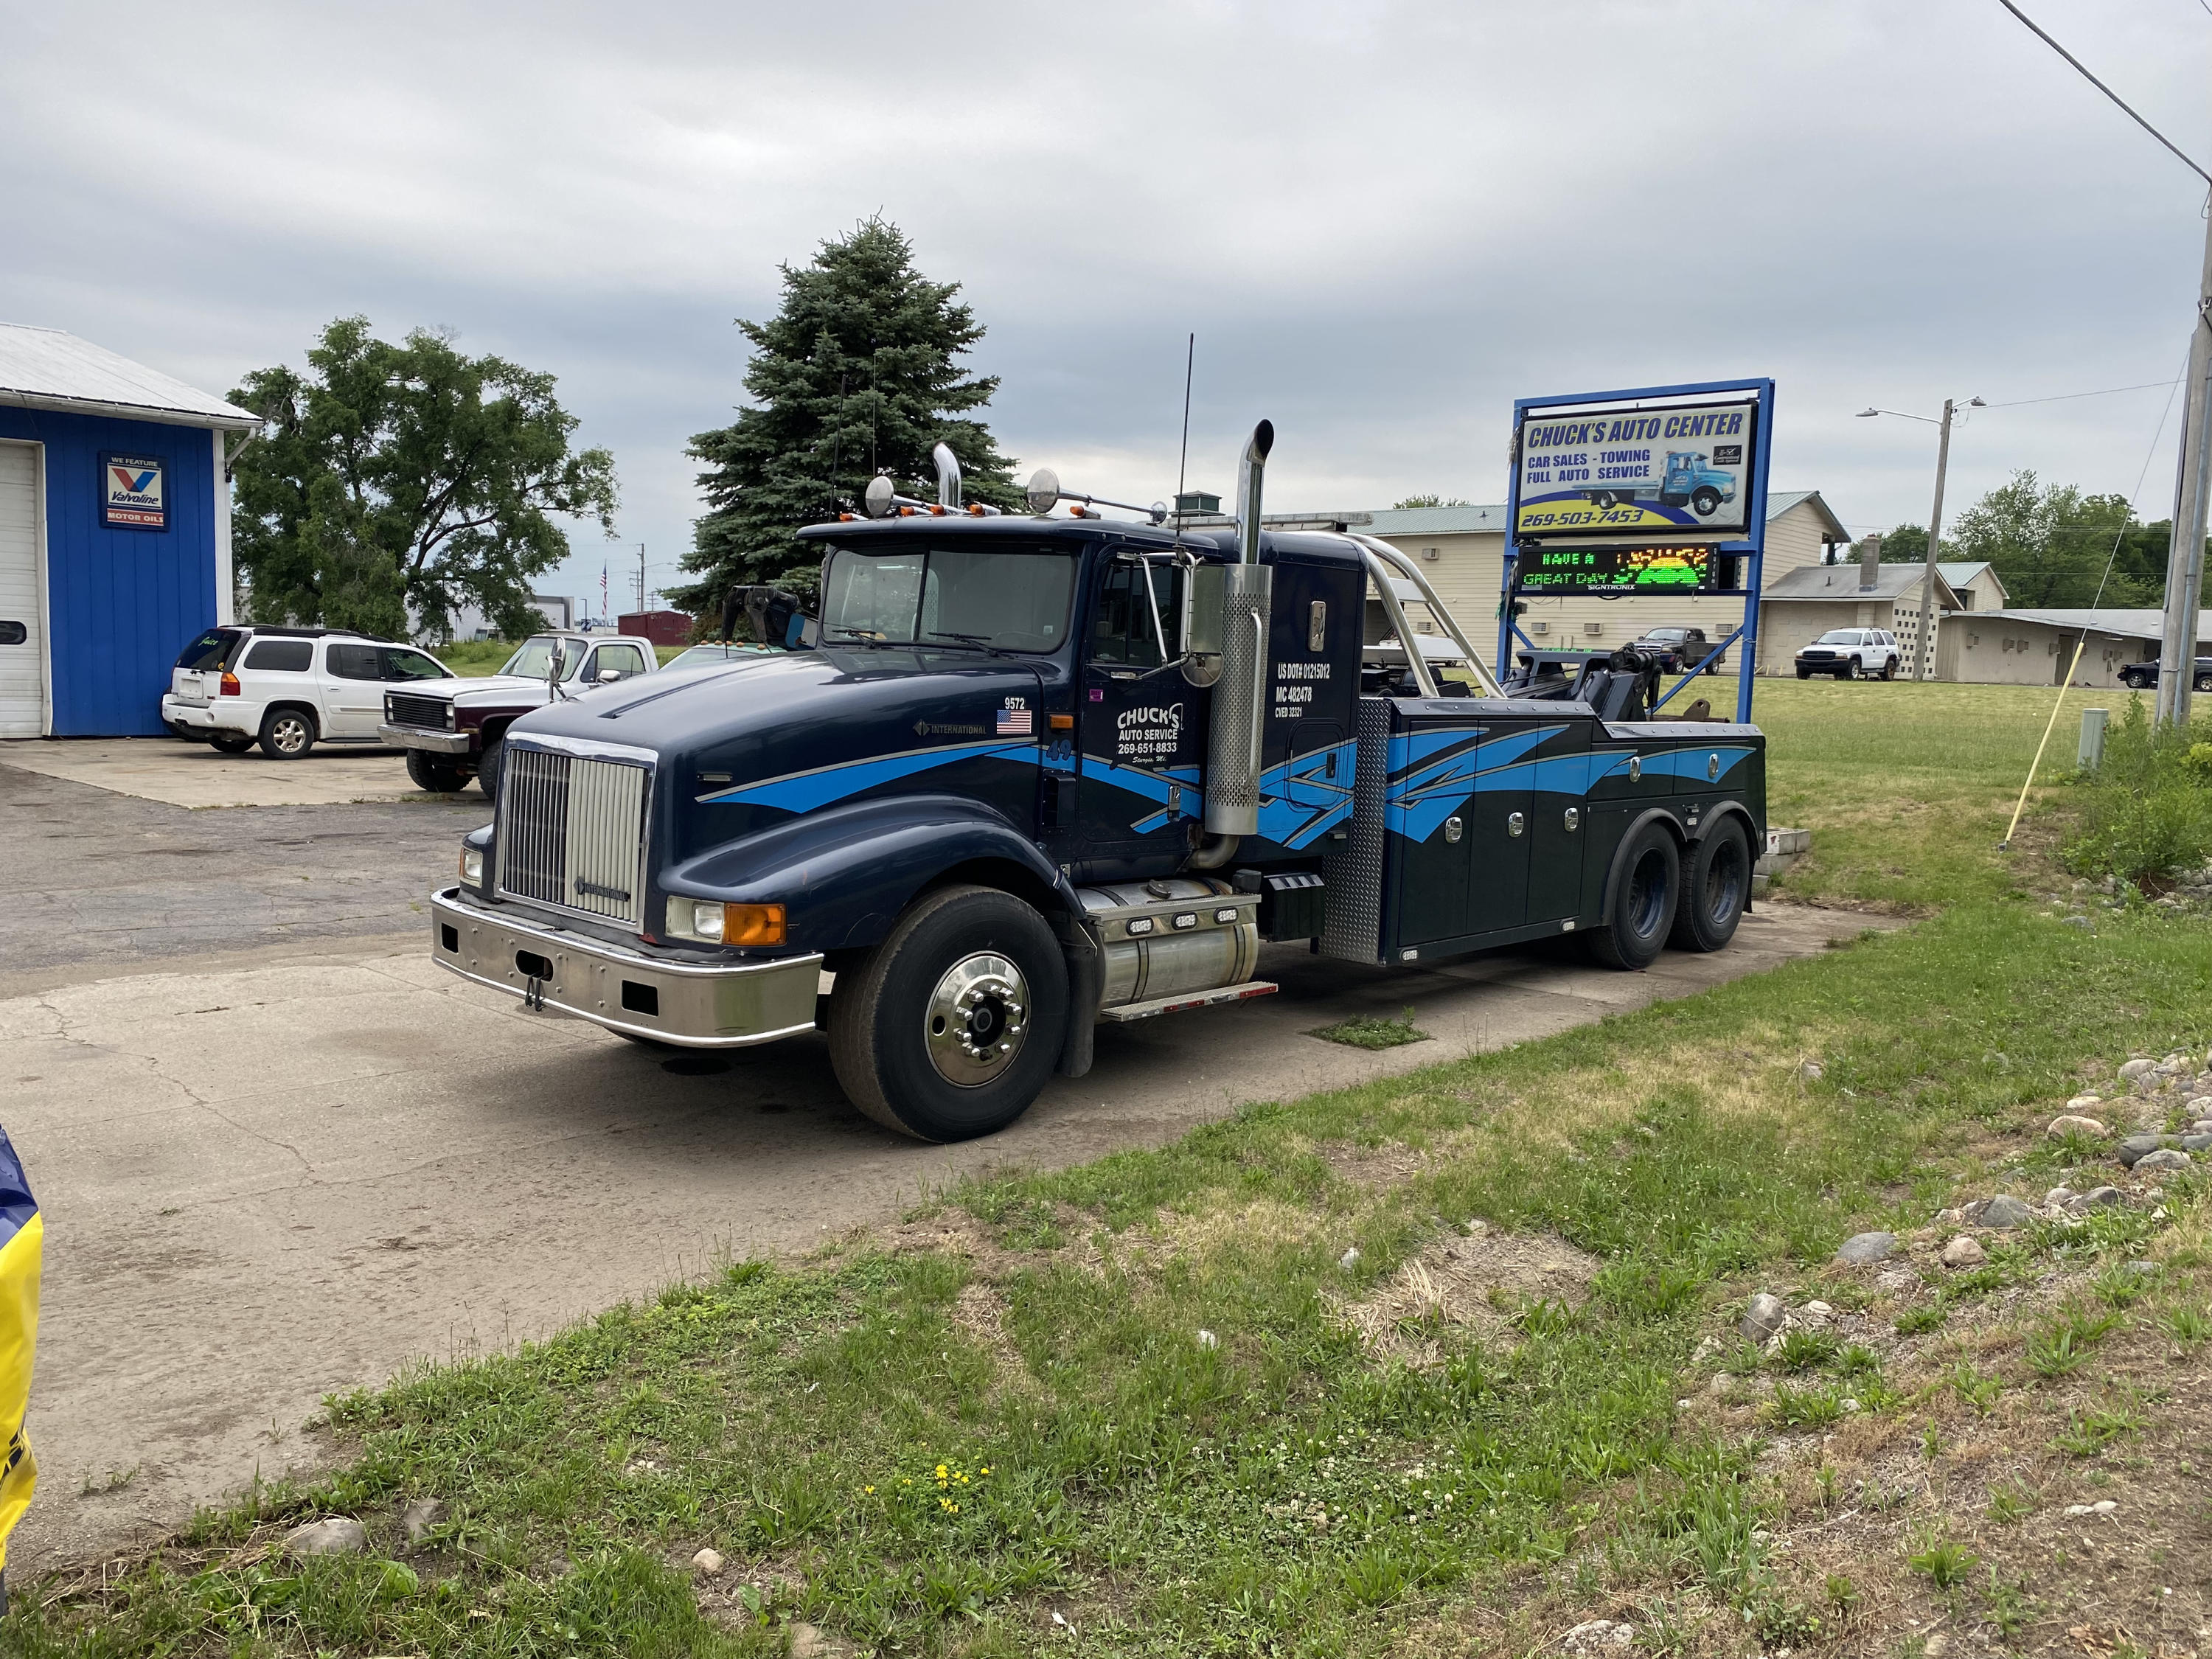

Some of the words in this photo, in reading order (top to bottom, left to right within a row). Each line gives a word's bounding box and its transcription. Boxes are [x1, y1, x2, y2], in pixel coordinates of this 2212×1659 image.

[1528, 422, 1607, 448] CHUCK'S
[1607, 417, 1661, 442] AUTO
[1664, 413, 1743, 439] CENTER
[125, 458, 158, 467] FEATURE
[1528, 456, 1551, 469] CAR
[1553, 453, 1587, 467] SALES
[1600, 449, 1651, 464] TOWING
[1527, 471, 1551, 484] FULL
[1558, 468, 1590, 482] AUTO
[1598, 465, 1650, 479] SERVICE
[111, 490, 159, 504] Valvoline
[108, 512, 141, 521] MOTOR
[1521, 509, 1644, 527] 269-503-7453
[1543, 553, 1579, 566] HAVE
[1585, 553, 1595, 565] A
[1523, 573, 1572, 585] GREAT
[1576, 572, 1608, 585] DAY
[1278, 663, 1286, 680] US
[1287, 663, 1303, 679] DOT#
[1276, 686, 1287, 703] MC
[1287, 686, 1312, 703] 482478
[1004, 697, 1025, 710] 9572
[931, 725, 987, 735] INTERNATIONAL
[1119, 729, 1143, 741] AUTO
[1144, 728, 1178, 740] SERVICE
[1046, 739, 1071, 761] 49
[1118, 742, 1177, 754] 269-651-8833
[585, 884, 627, 901] INTERNATIONAL
